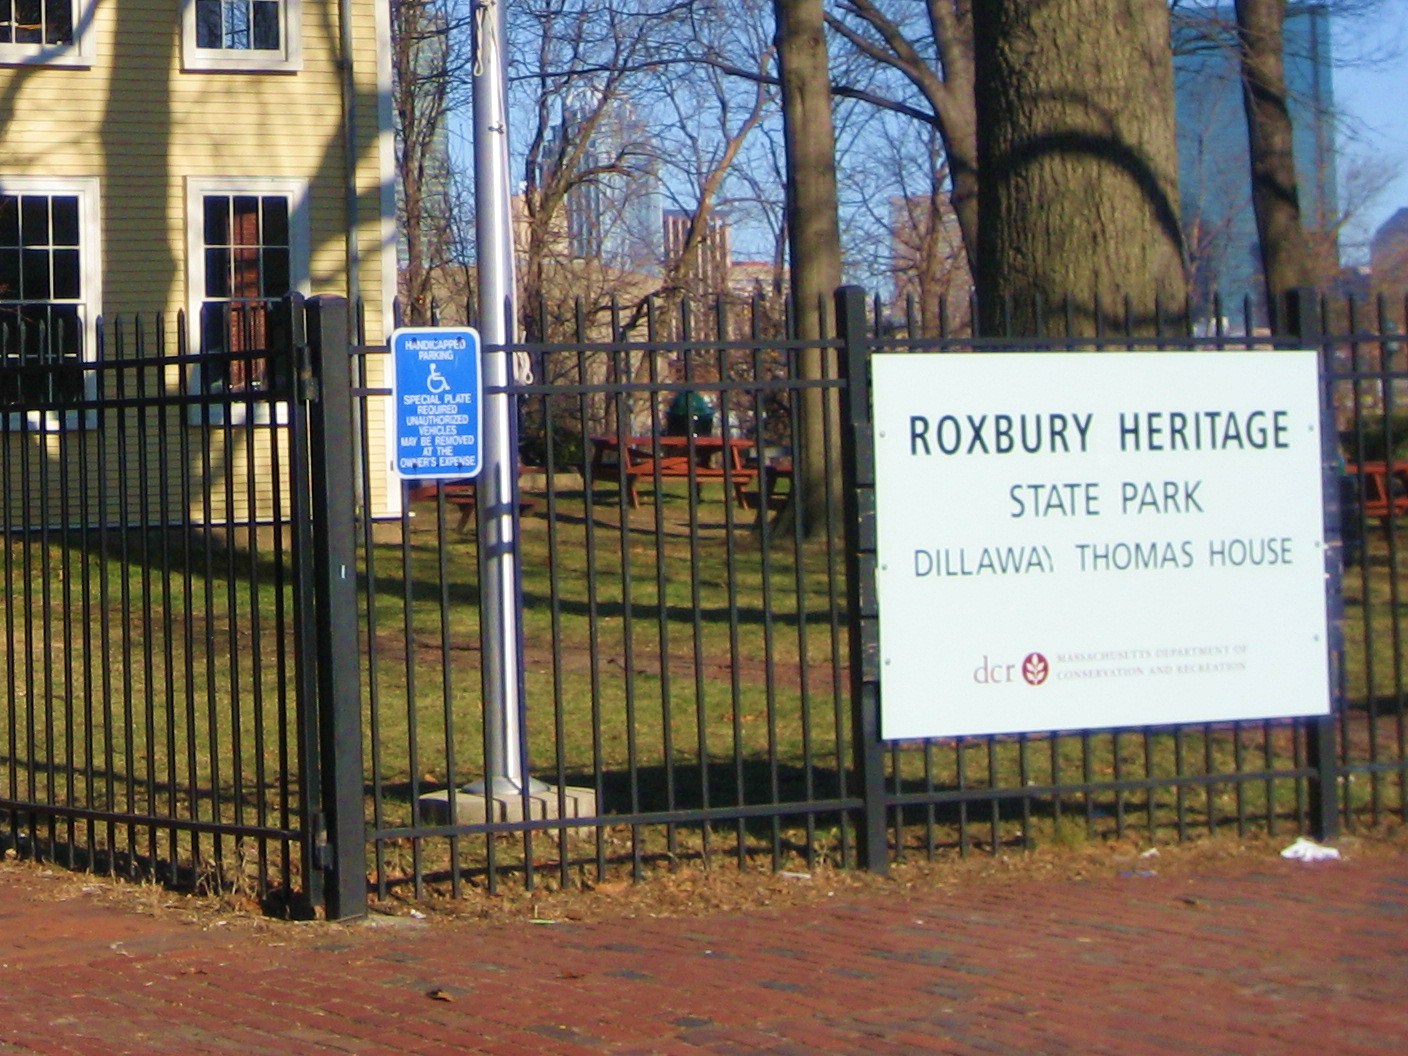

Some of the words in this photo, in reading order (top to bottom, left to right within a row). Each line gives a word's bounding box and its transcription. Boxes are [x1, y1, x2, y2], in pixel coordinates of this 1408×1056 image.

[418, 350, 453, 360] PARKING
[403, 394, 441, 405] SPECIAL
[444, 393, 471, 404] PLATE
[417, 404, 458, 415] REQUIRED
[406, 414, 469, 426] UNAUTHORIZED
[418, 425, 457, 435] VEHICLES
[909, 413, 1094, 456] ROXBURY
[1119, 411, 1290, 451] HERITAGE
[400, 436, 418, 446] MAY
[420, 436, 432, 446] BE
[435, 434, 475, 445] REMOVED
[422, 446, 433, 456] AT
[436, 446, 453, 455] THE
[439, 455, 476, 466] EXPENSE
[1009, 483, 1100, 518] STATE
[1121, 480, 1204, 514] PARK
[1075, 541, 1193, 572] THOMAS
[1209, 538, 1293, 567] HOUSE
[1056, 651, 1152, 664] MASSACHUSETTS
[1155, 646, 1230, 659] DEPARTMENT
[973, 655, 1016, 684] dcr
[1056, 667, 1144, 681] CONSERVATION
[1149, 665, 1173, 675] AND
[1177, 661, 1247, 674] RECREATION
